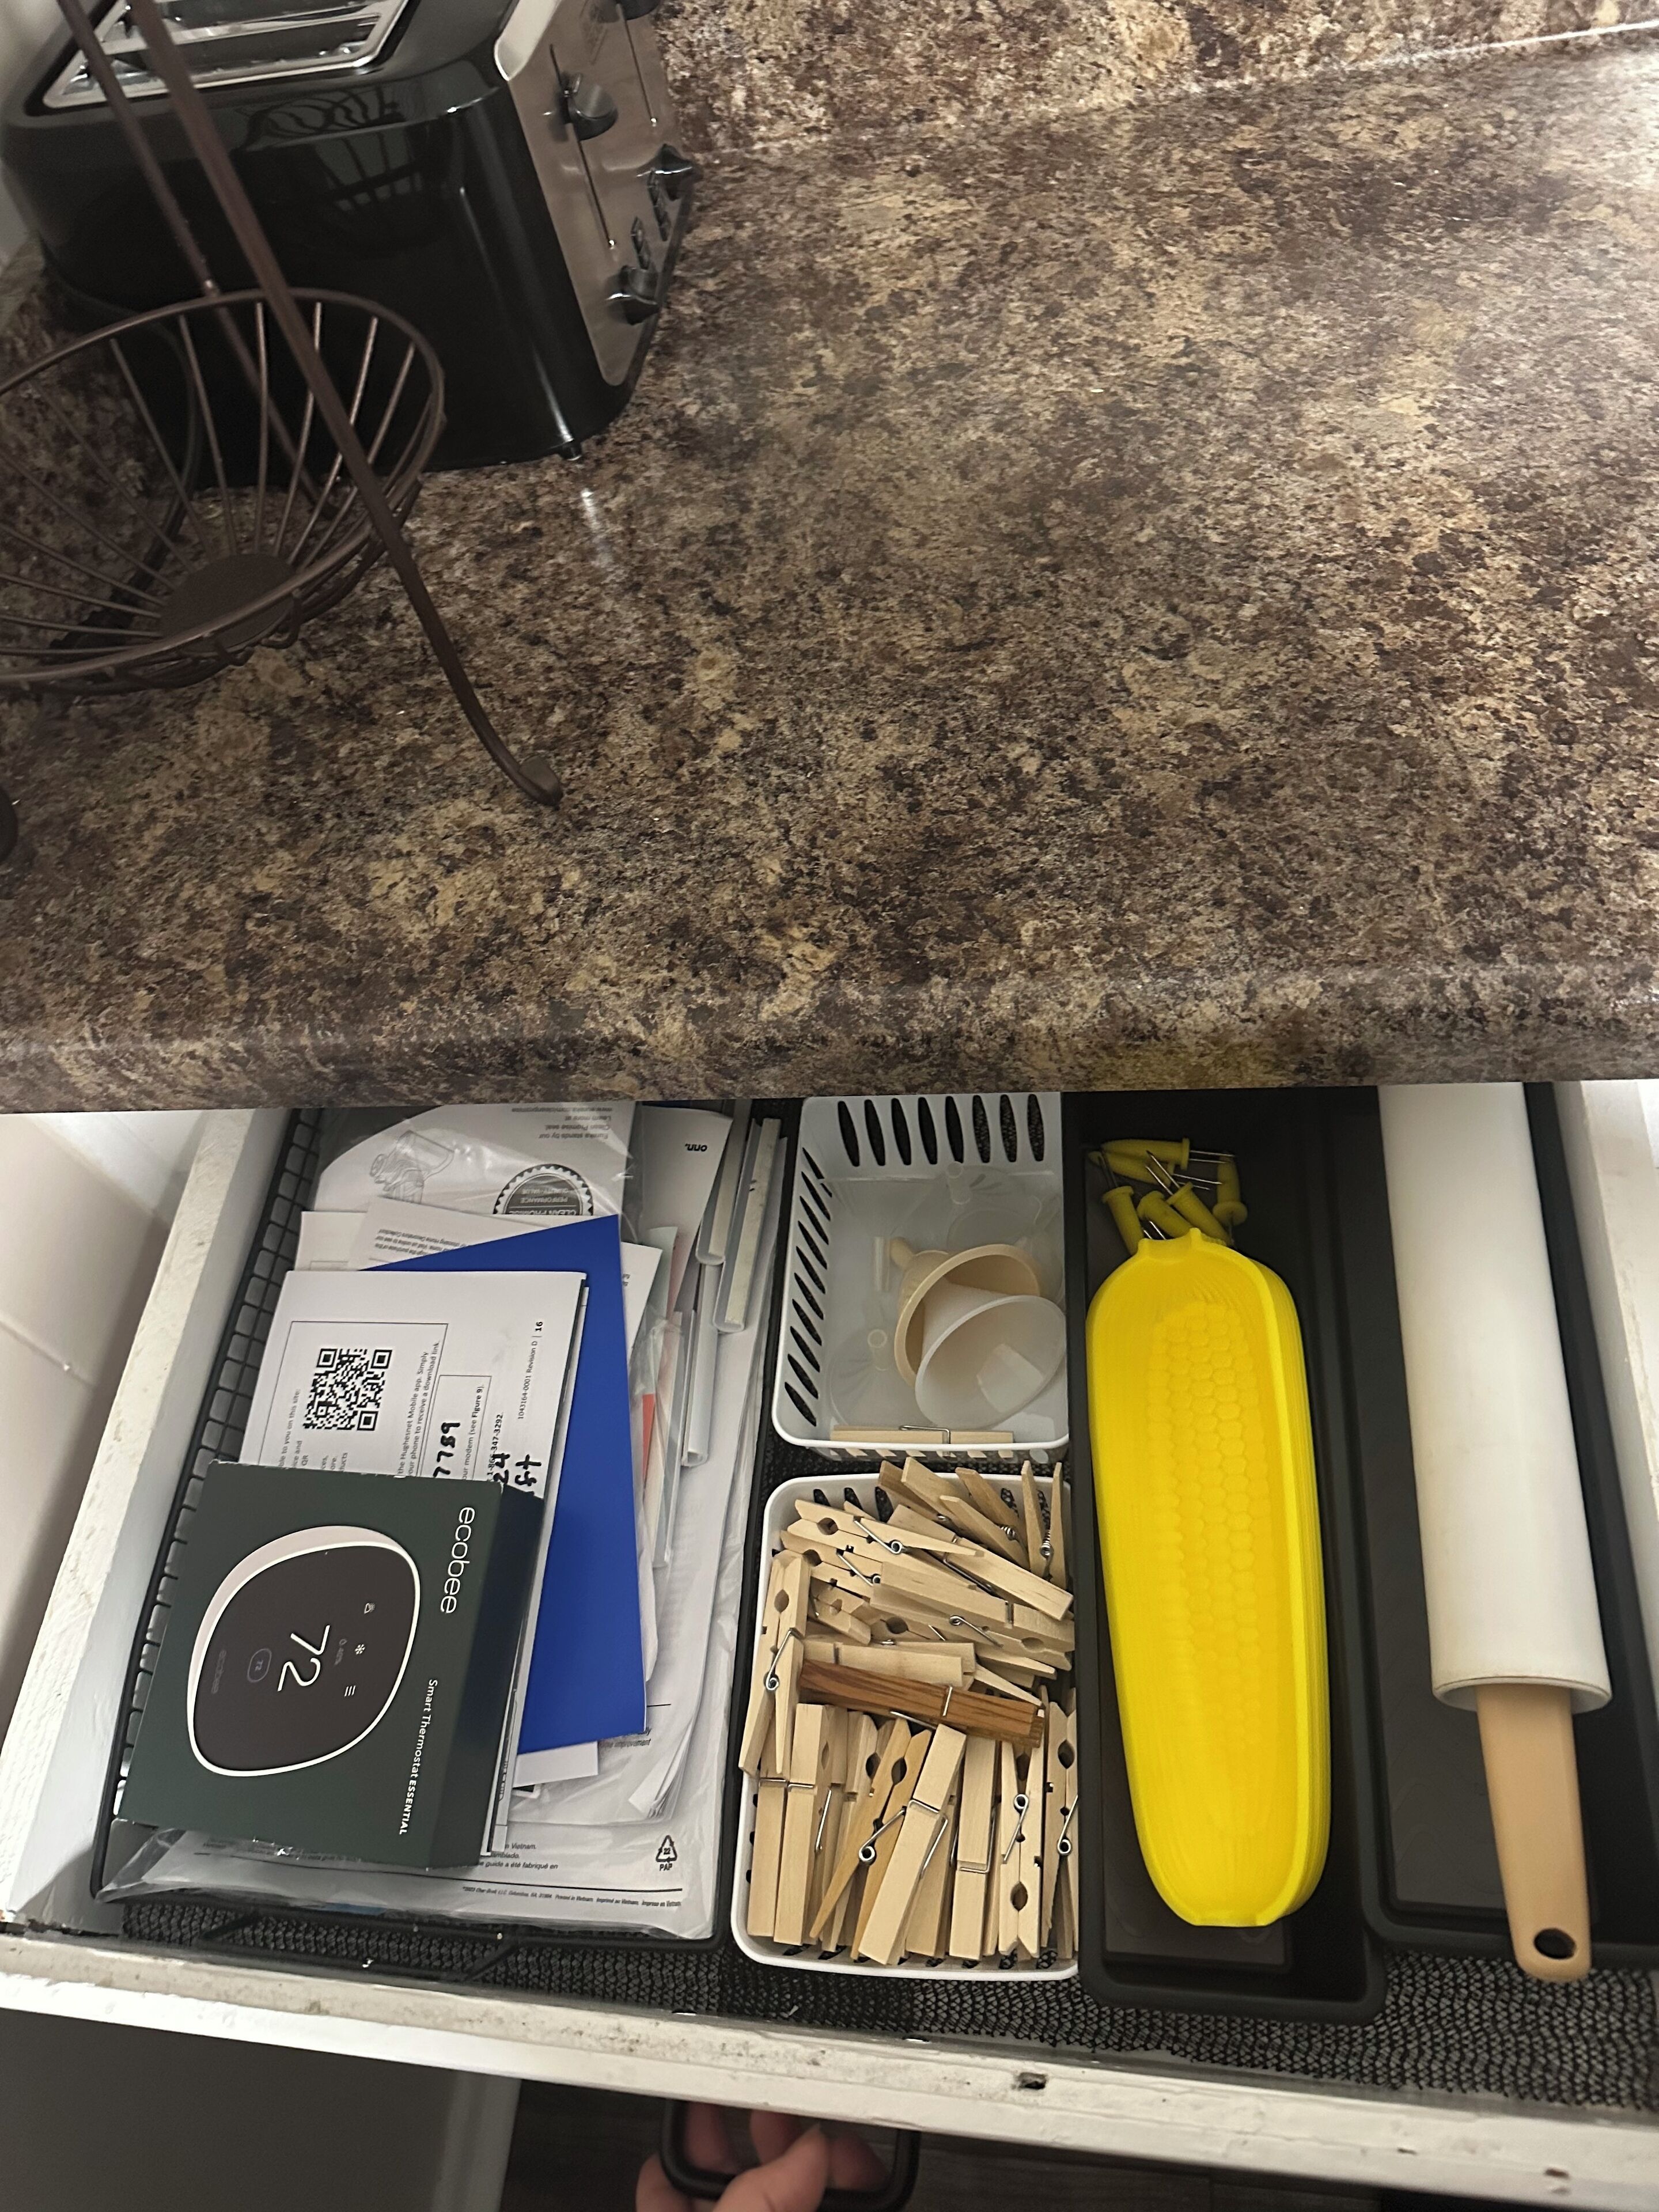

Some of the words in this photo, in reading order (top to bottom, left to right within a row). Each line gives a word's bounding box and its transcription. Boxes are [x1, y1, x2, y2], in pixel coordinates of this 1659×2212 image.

[684, 1143, 708, 1152] onn.
[431, 1340, 440, 1355] link.
[416, 1351, 429, 1374] Simply
[423, 1356, 437, 1391] download
[518, 1375, 531, 1419] 1043164-0001
[526, 1347, 536, 1373] Revision
[535, 1321, 543, 1332] 16
[414, 1377, 422, 1392] app.
[289, 1404, 297, 1419] this
[408, 1393, 419, 1419] Mobile
[417, 1398, 427, 1425] receive
[471, 1395, 482, 1418] Figure
[288, 1420, 294, 1430] on
[414, 1426, 422, 1434] to
[469, 1419, 477, 1435] (see
[282, 1446, 288, 1455] to
[295, 1440, 303, 1455] and
[400, 1420, 414, 1460] Hughesnet
[410, 1435, 420, 1459] phone
[464, 1436, 474, 1465] modem
[301, 1455, 309, 1466] QR
[493, 1453, 510, 1484] 24
[440, 1505, 476, 1614] ecobee
[277, 1624, 331, 1692] 72
[211, 1649, 226, 1694] ecobee
[423, 1679, 438, 1712] Smart
[410, 1714, 431, 1778] Thermostat
[399, 1779, 416, 1835] ESSENTIAL
[522, 1861, 548, 1870] fabriqué
[659, 1863, 673, 1872] PAP
